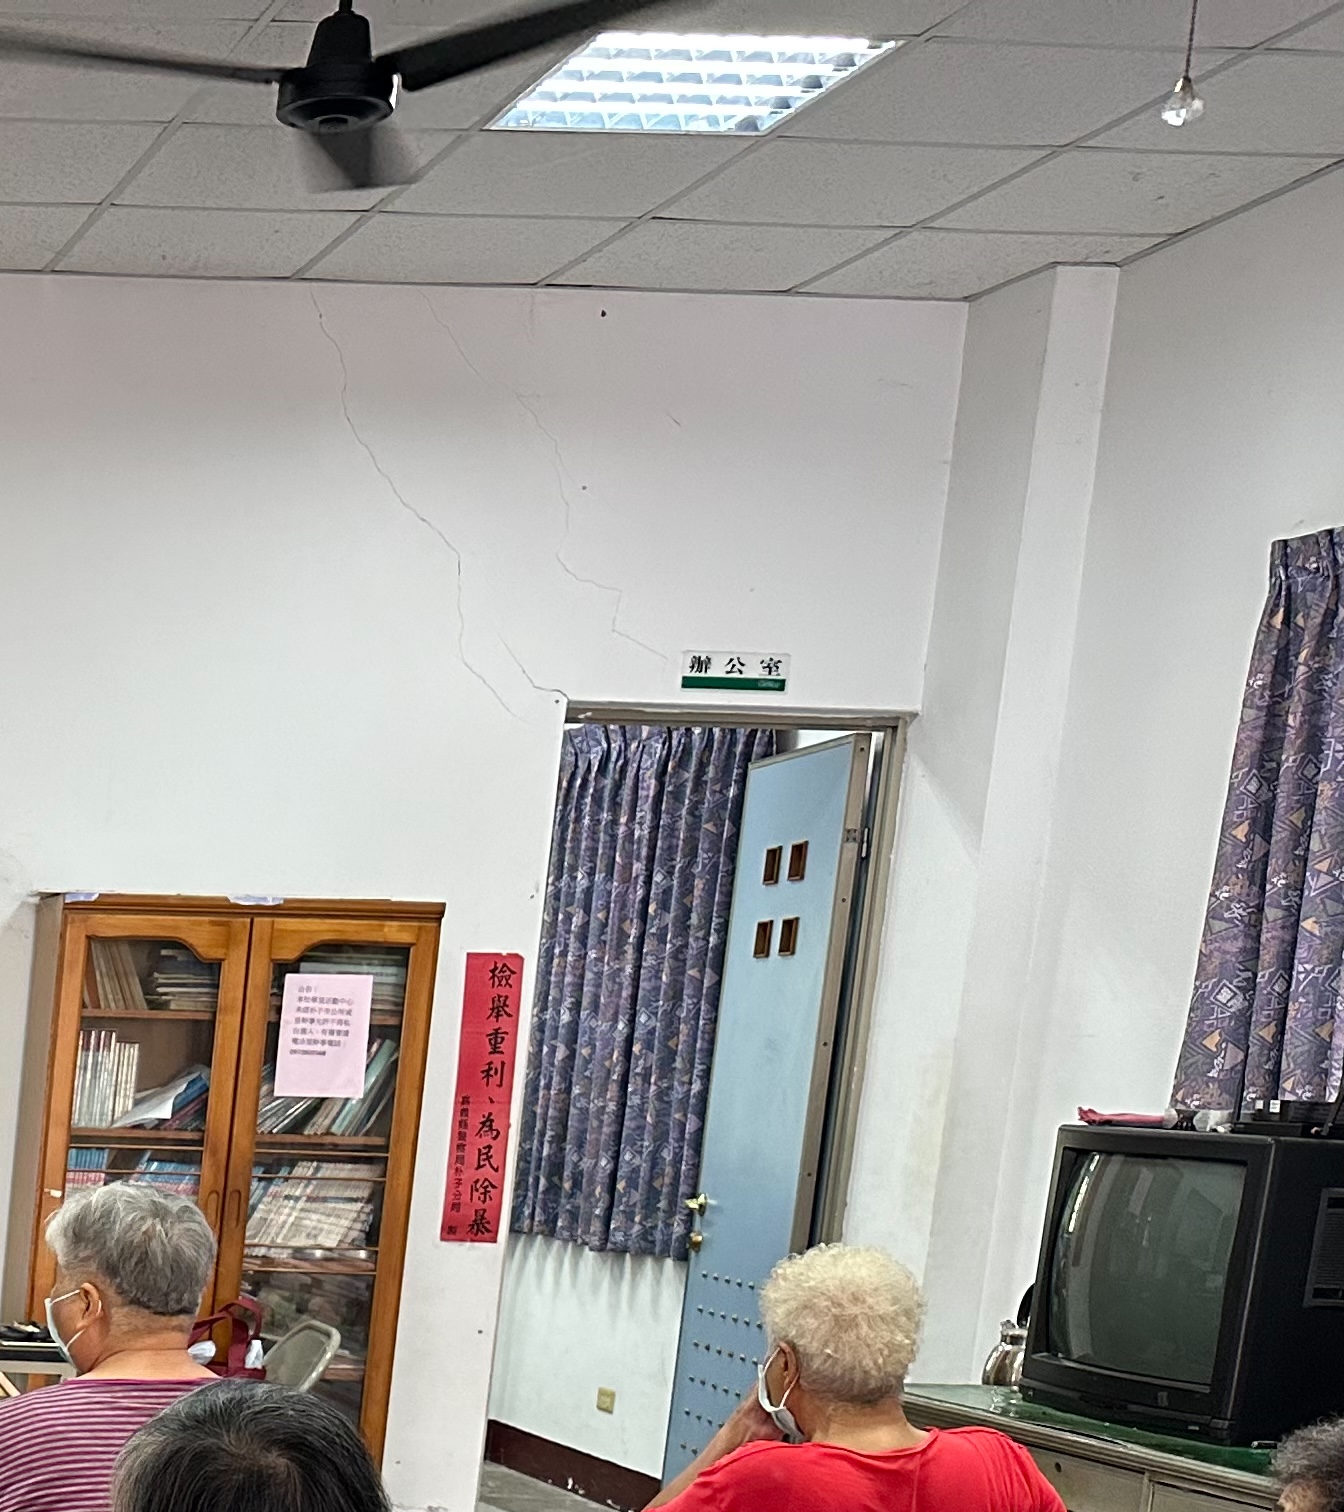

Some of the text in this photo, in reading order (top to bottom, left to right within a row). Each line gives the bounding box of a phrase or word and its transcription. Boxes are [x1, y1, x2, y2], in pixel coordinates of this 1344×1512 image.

[689, 655, 783, 676] 辦公室
[466, 960, 517, 1237] 檢舉重利、為民除暴
